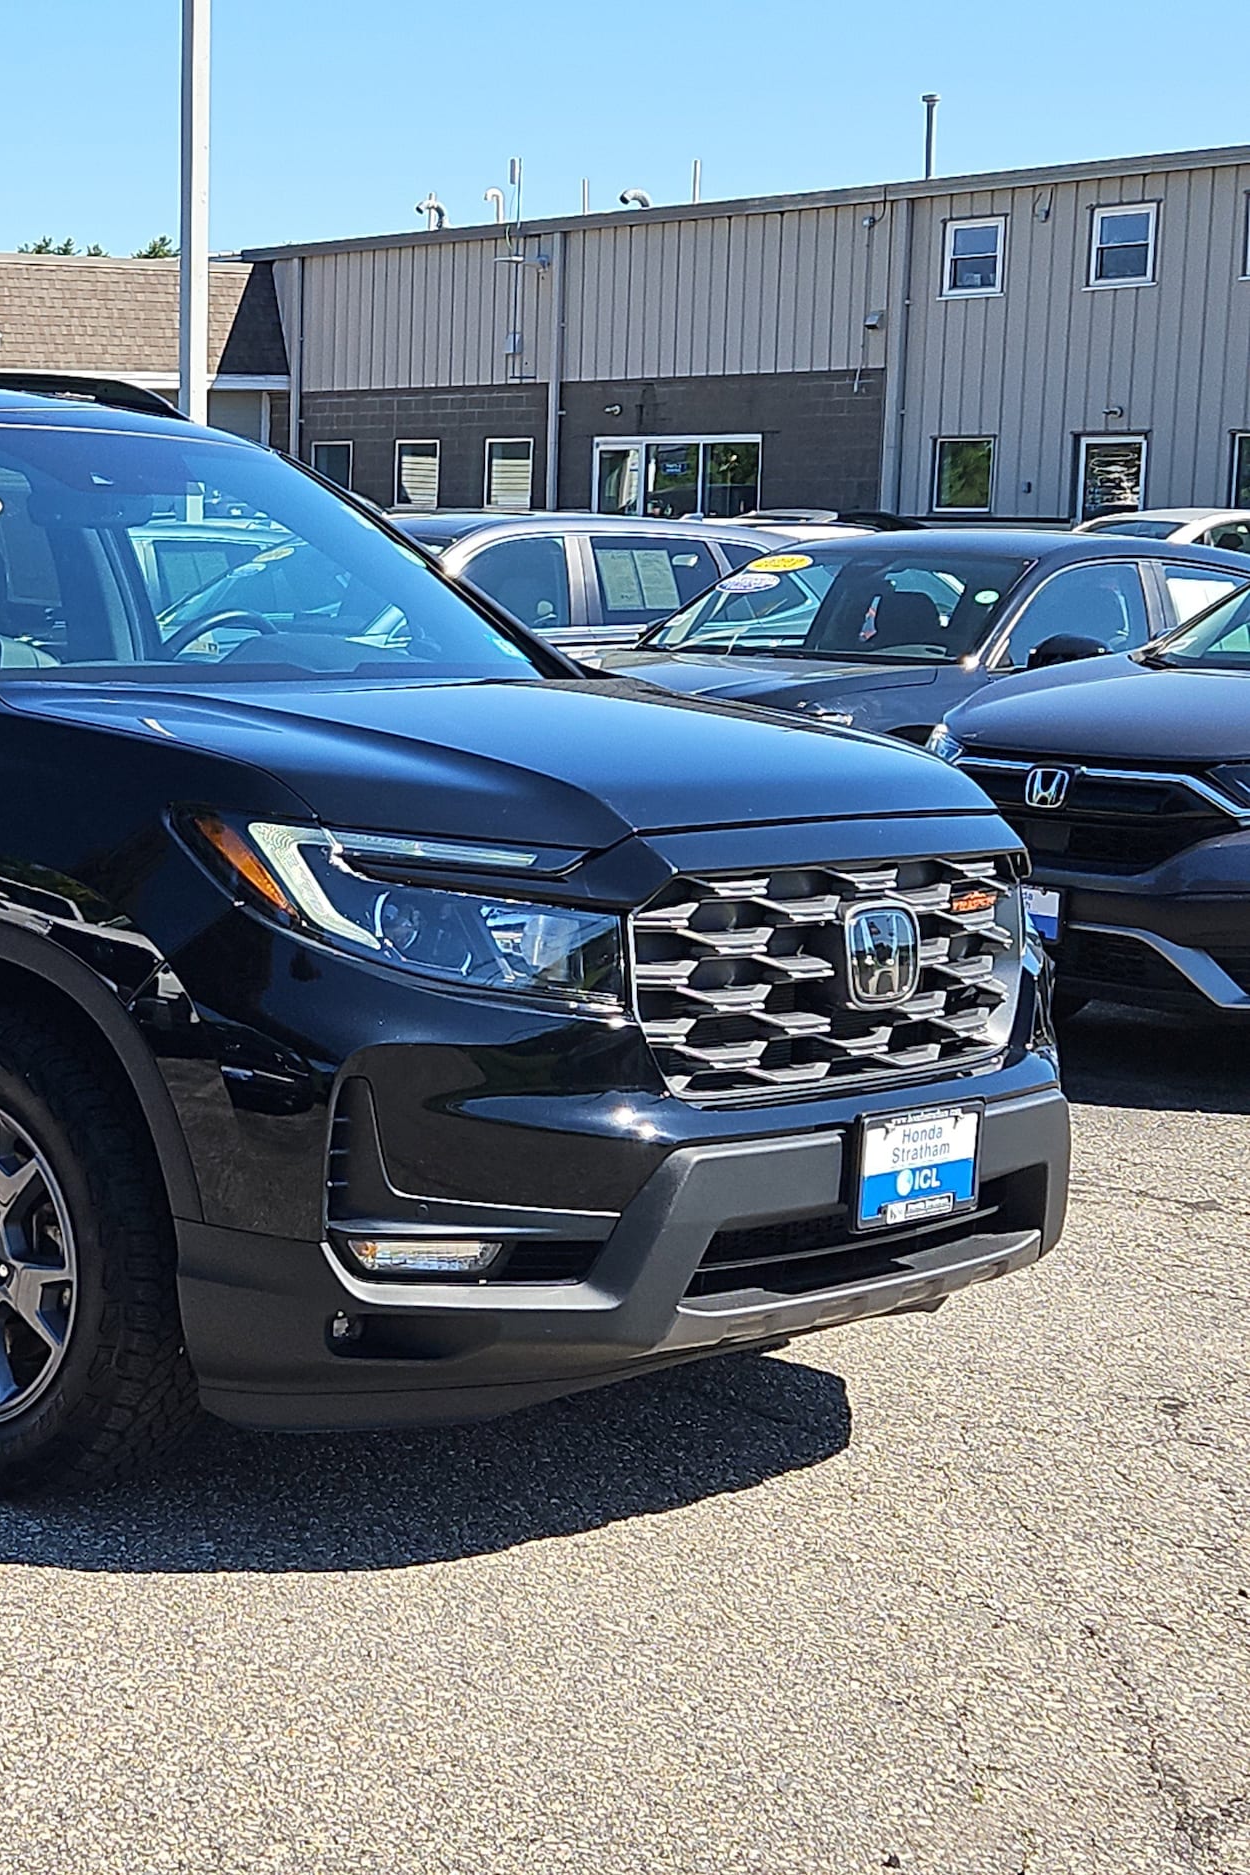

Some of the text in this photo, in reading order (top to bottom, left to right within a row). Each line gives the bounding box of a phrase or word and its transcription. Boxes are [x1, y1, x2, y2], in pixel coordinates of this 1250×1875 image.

[902, 1125, 943, 1144] Honda
[892, 1143, 950, 1164] Stratham
[914, 1167, 941, 1190] ICL
